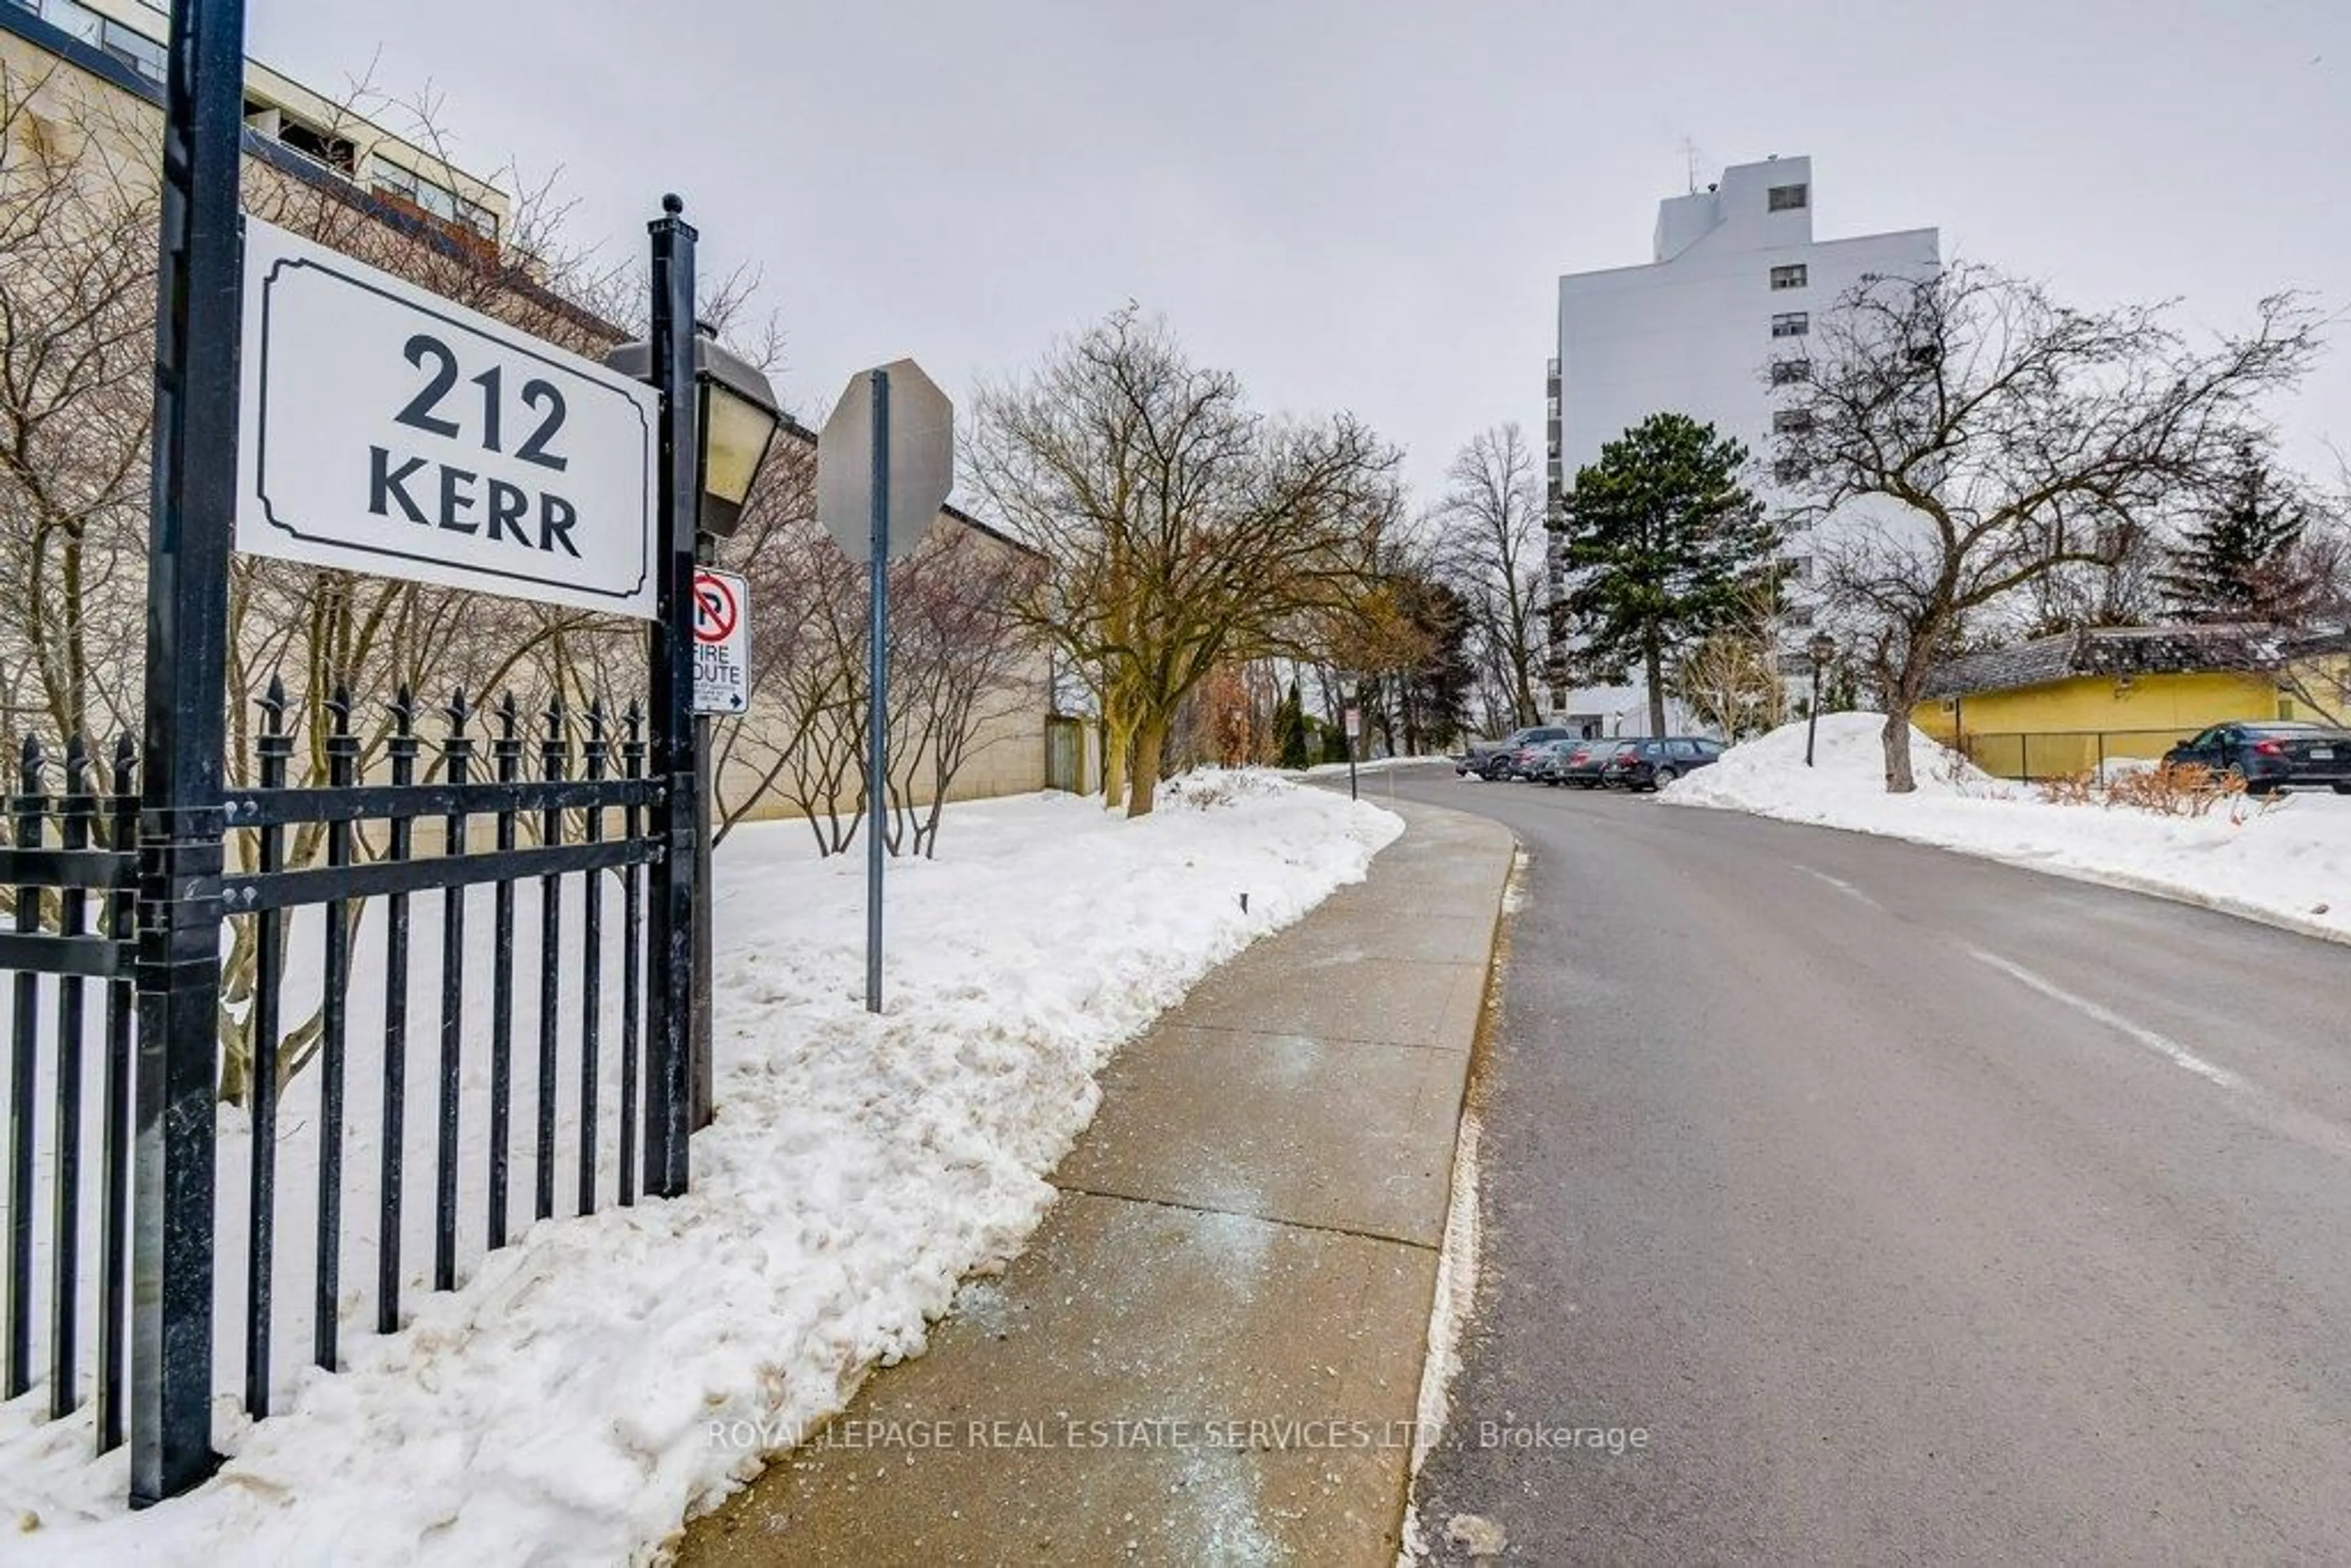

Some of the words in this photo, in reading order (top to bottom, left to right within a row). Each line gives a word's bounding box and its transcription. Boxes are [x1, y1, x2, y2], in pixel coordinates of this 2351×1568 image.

[394, 334, 568, 472] 212
[368, 446, 582, 558] KERR
[693, 663, 740, 685] OUTE
